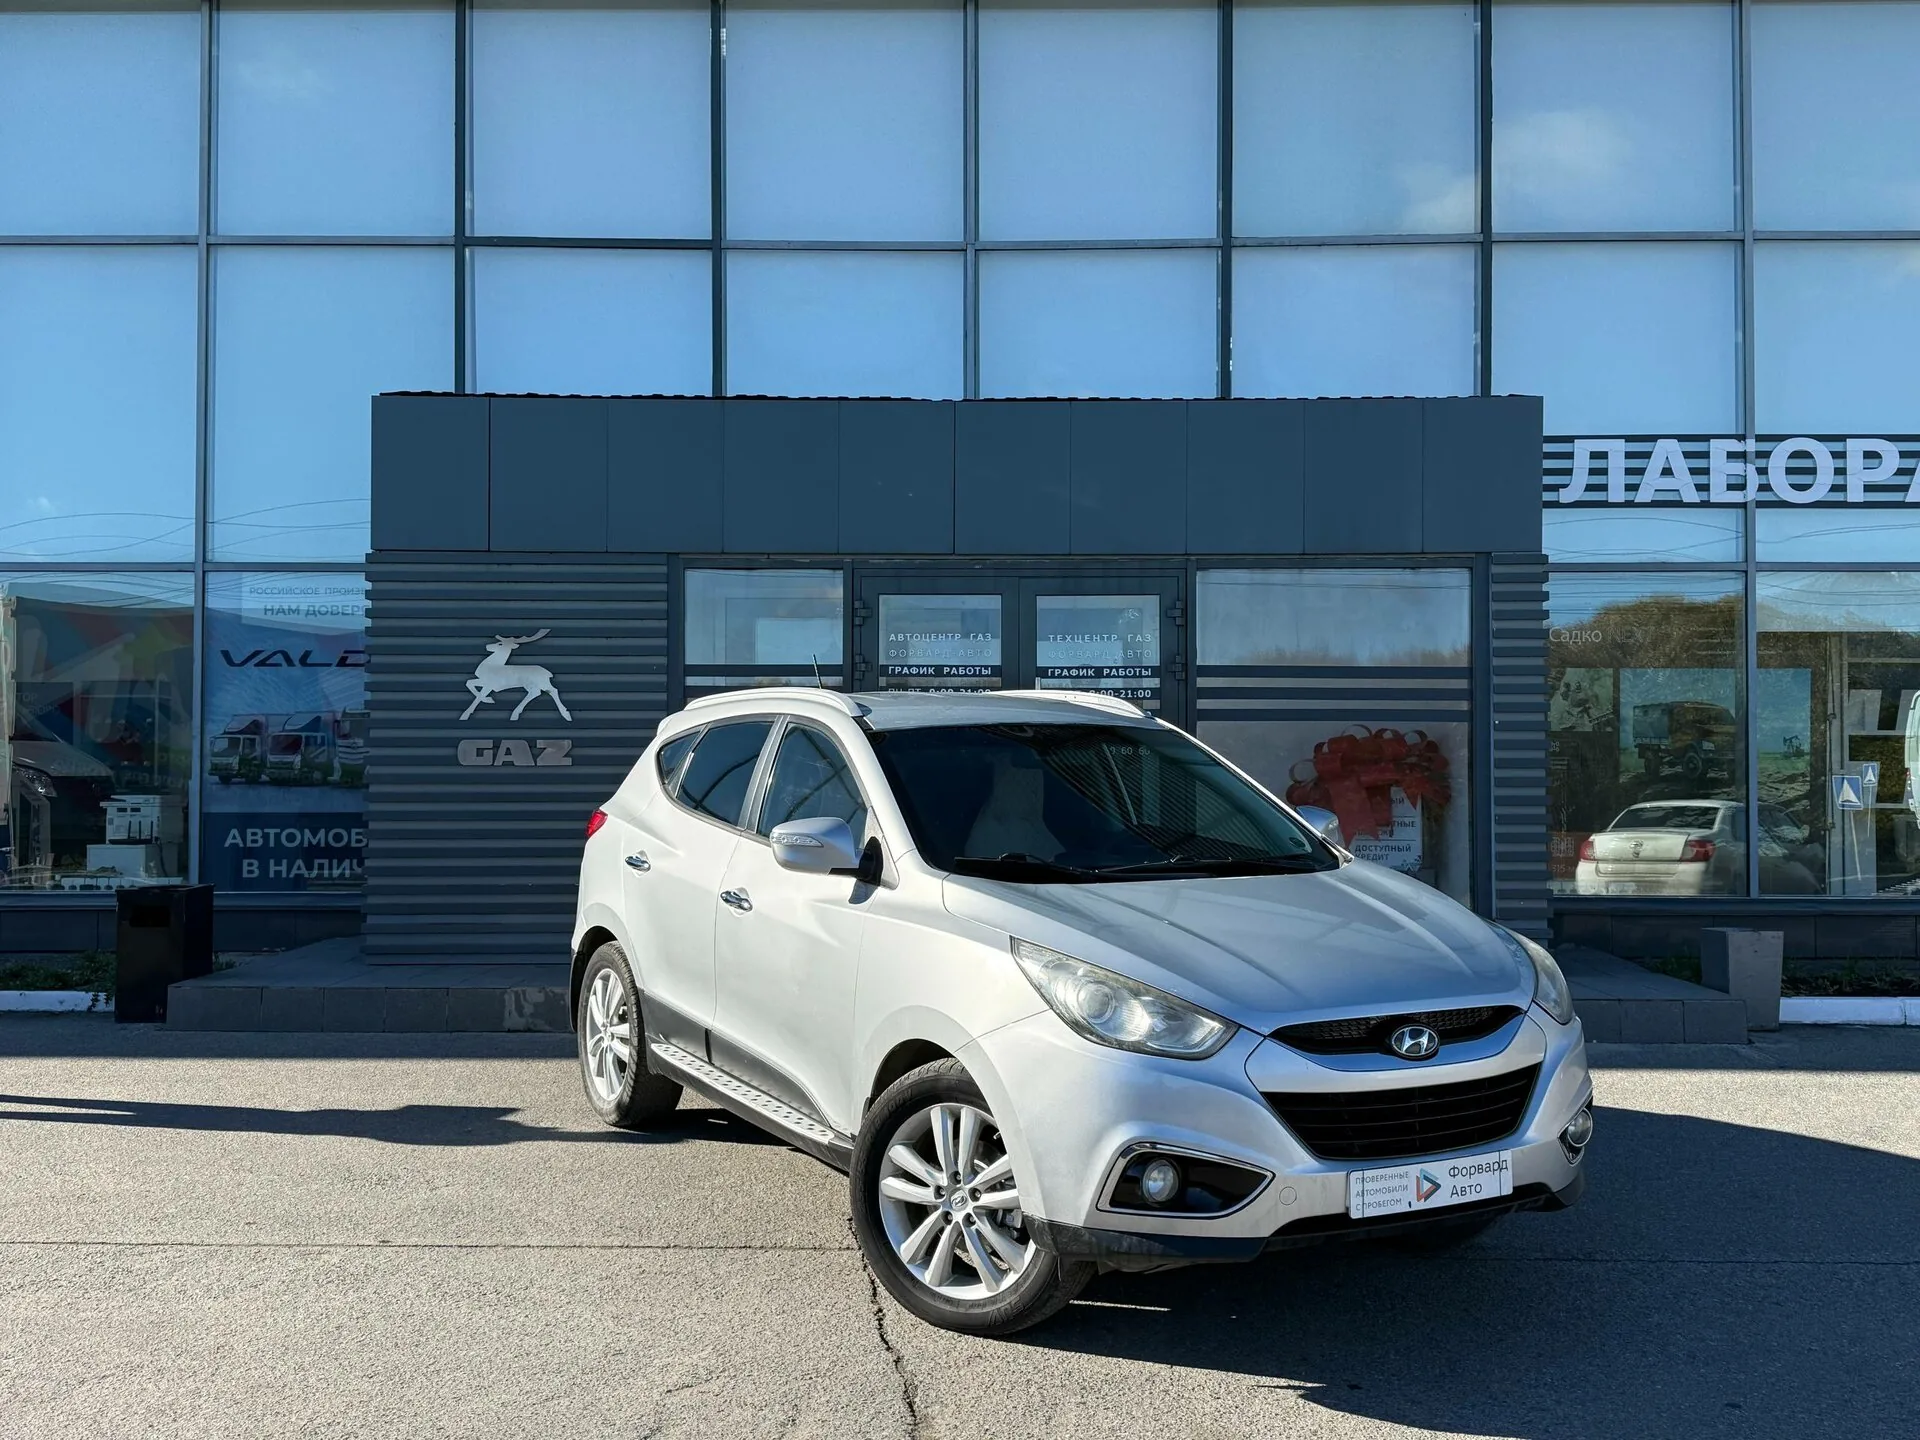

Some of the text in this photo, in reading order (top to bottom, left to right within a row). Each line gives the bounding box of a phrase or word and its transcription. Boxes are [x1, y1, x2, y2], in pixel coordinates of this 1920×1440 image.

[1558, 437, 1920, 504] ЛАБОР
[264, 604, 300, 616] НАМ
[889, 633, 992, 643] АВТОЦЕНТР ГАЗ
[1048, 634, 1152, 643] ТЕХЦЕНТР ГАЗ
[1549, 626, 1602, 645] Садко
[888, 666, 992, 675] ГРАФИК РАБОТЫ
[1048, 668, 1152, 677] ГРАФИК РАБОТЫ
[457, 739, 573, 766] GAZ
[224, 828, 368, 848] АВТОМОБ
[1355, 844, 1412, 852] ДОСТУПНЫЙ
[242, 859, 260, 878] В
[1448, 1159, 1509, 1180] Форвард
[1355, 1171, 1409, 1185] ПРОВЕРЕННЫЕ
[1355, 1184, 1409, 1199] АВТОМОБИЛИ
[1450, 1183, 1483, 1199] Авто
[1362, 1198, 1402, 1210] ПРОБЕГОМ
